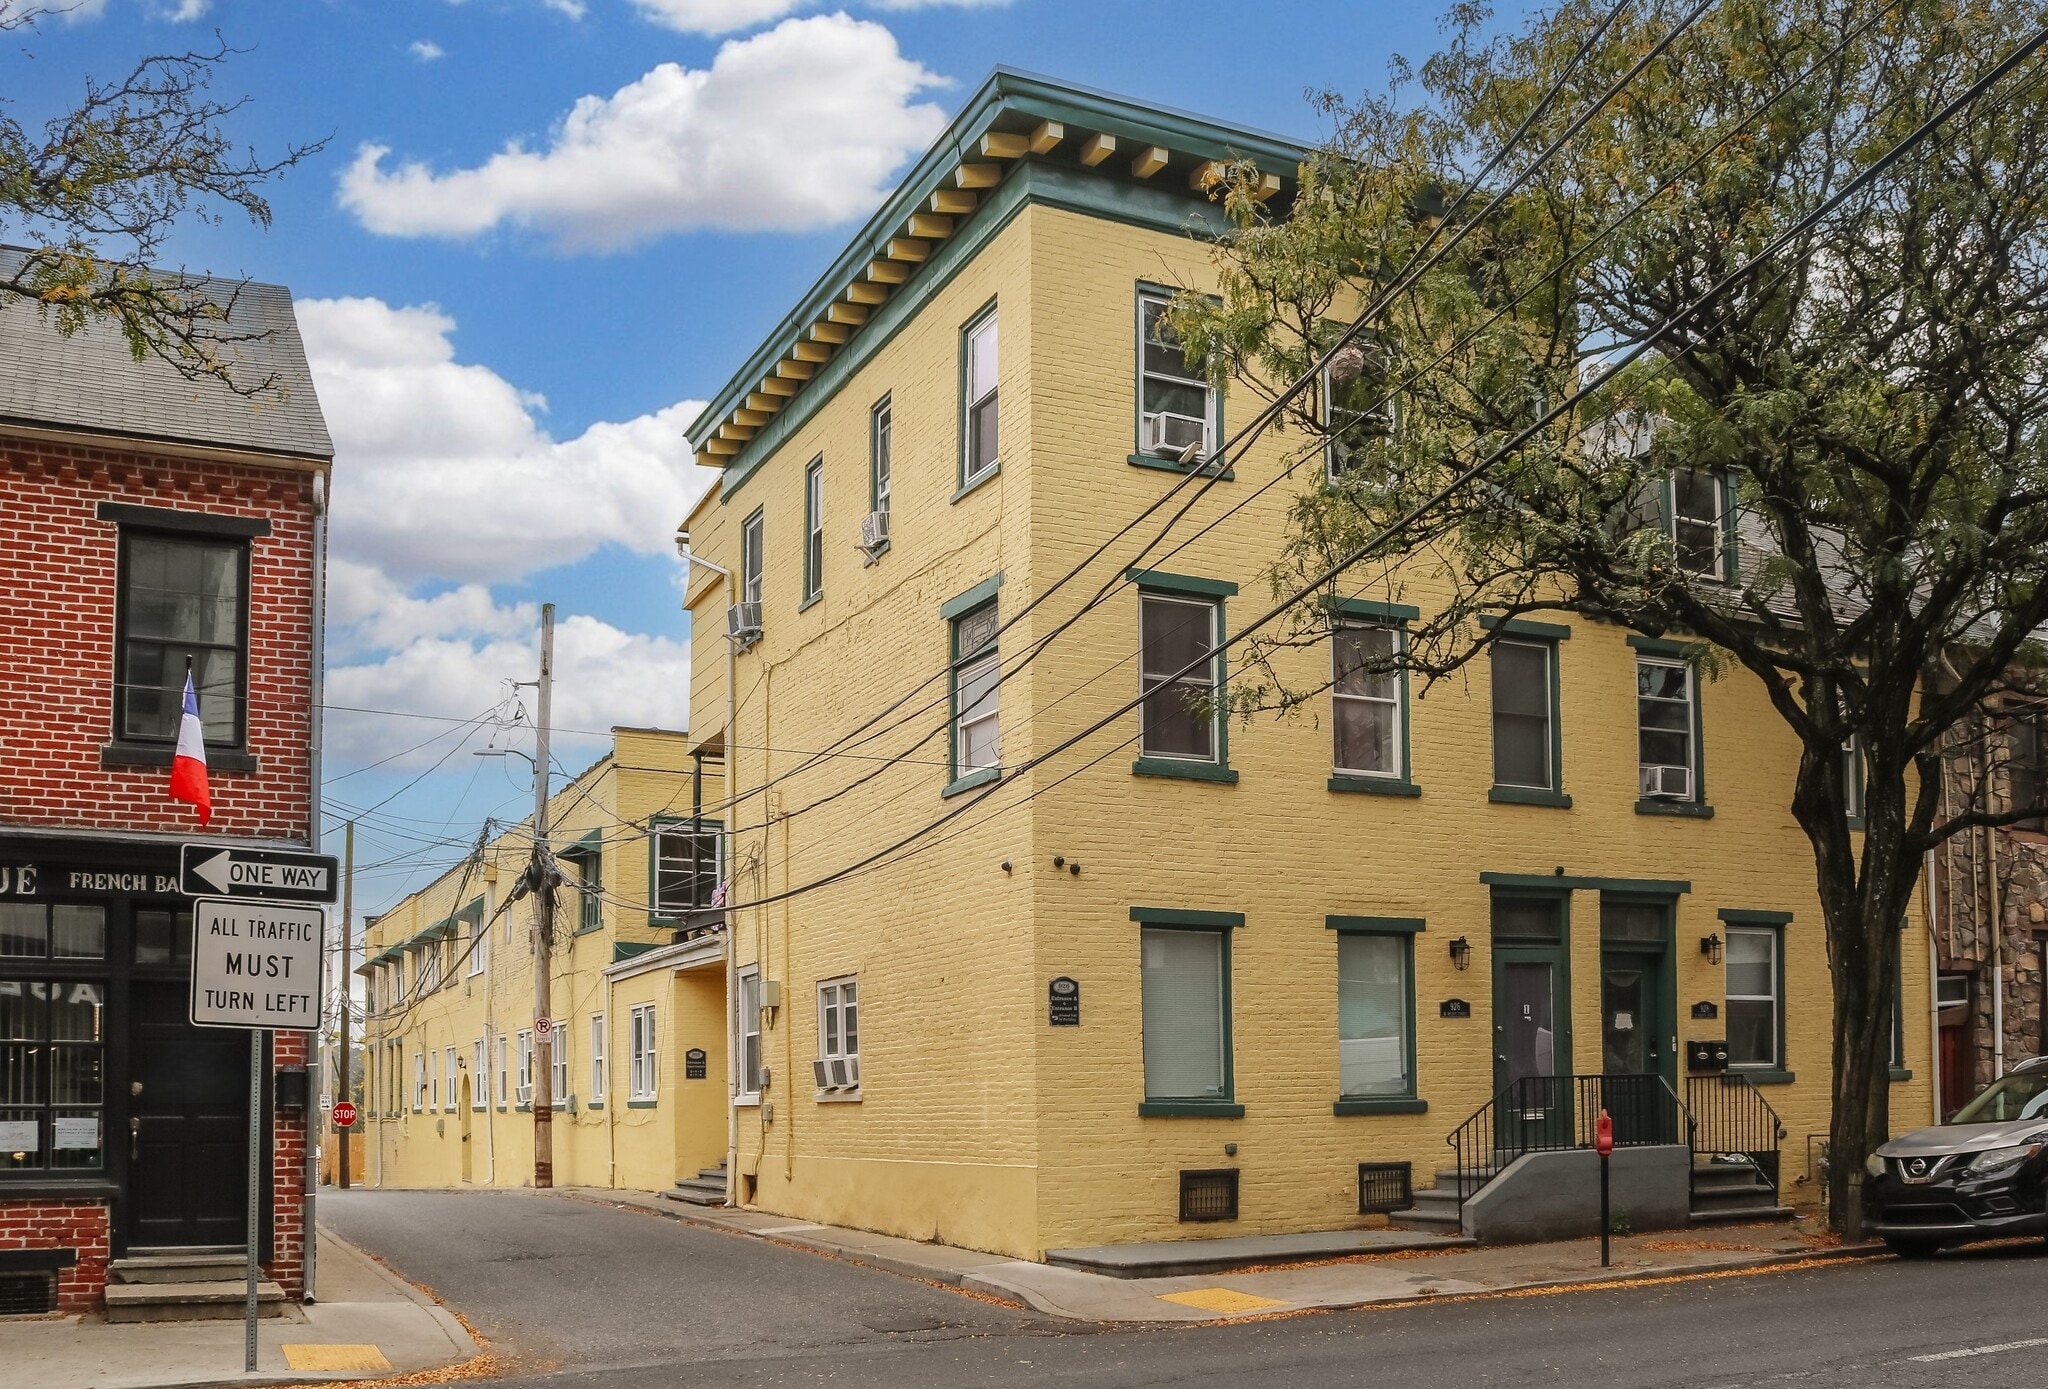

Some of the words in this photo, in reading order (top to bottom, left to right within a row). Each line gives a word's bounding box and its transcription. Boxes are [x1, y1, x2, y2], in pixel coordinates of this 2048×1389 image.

[69, 872, 147, 892] FRENCH
[230, 863, 273, 884] ONE
[282, 867, 321, 887] WAY
[210, 917, 239, 937] ALL
[248, 919, 312, 942] TRAFFIC
[226, 952, 294, 978] MUST
[205, 989, 254, 1010] TURN
[265, 993, 310, 1013] LEFT
[1450, 1002, 1460, 1011] 926
[334, 1109, 356, 1119] STOP
